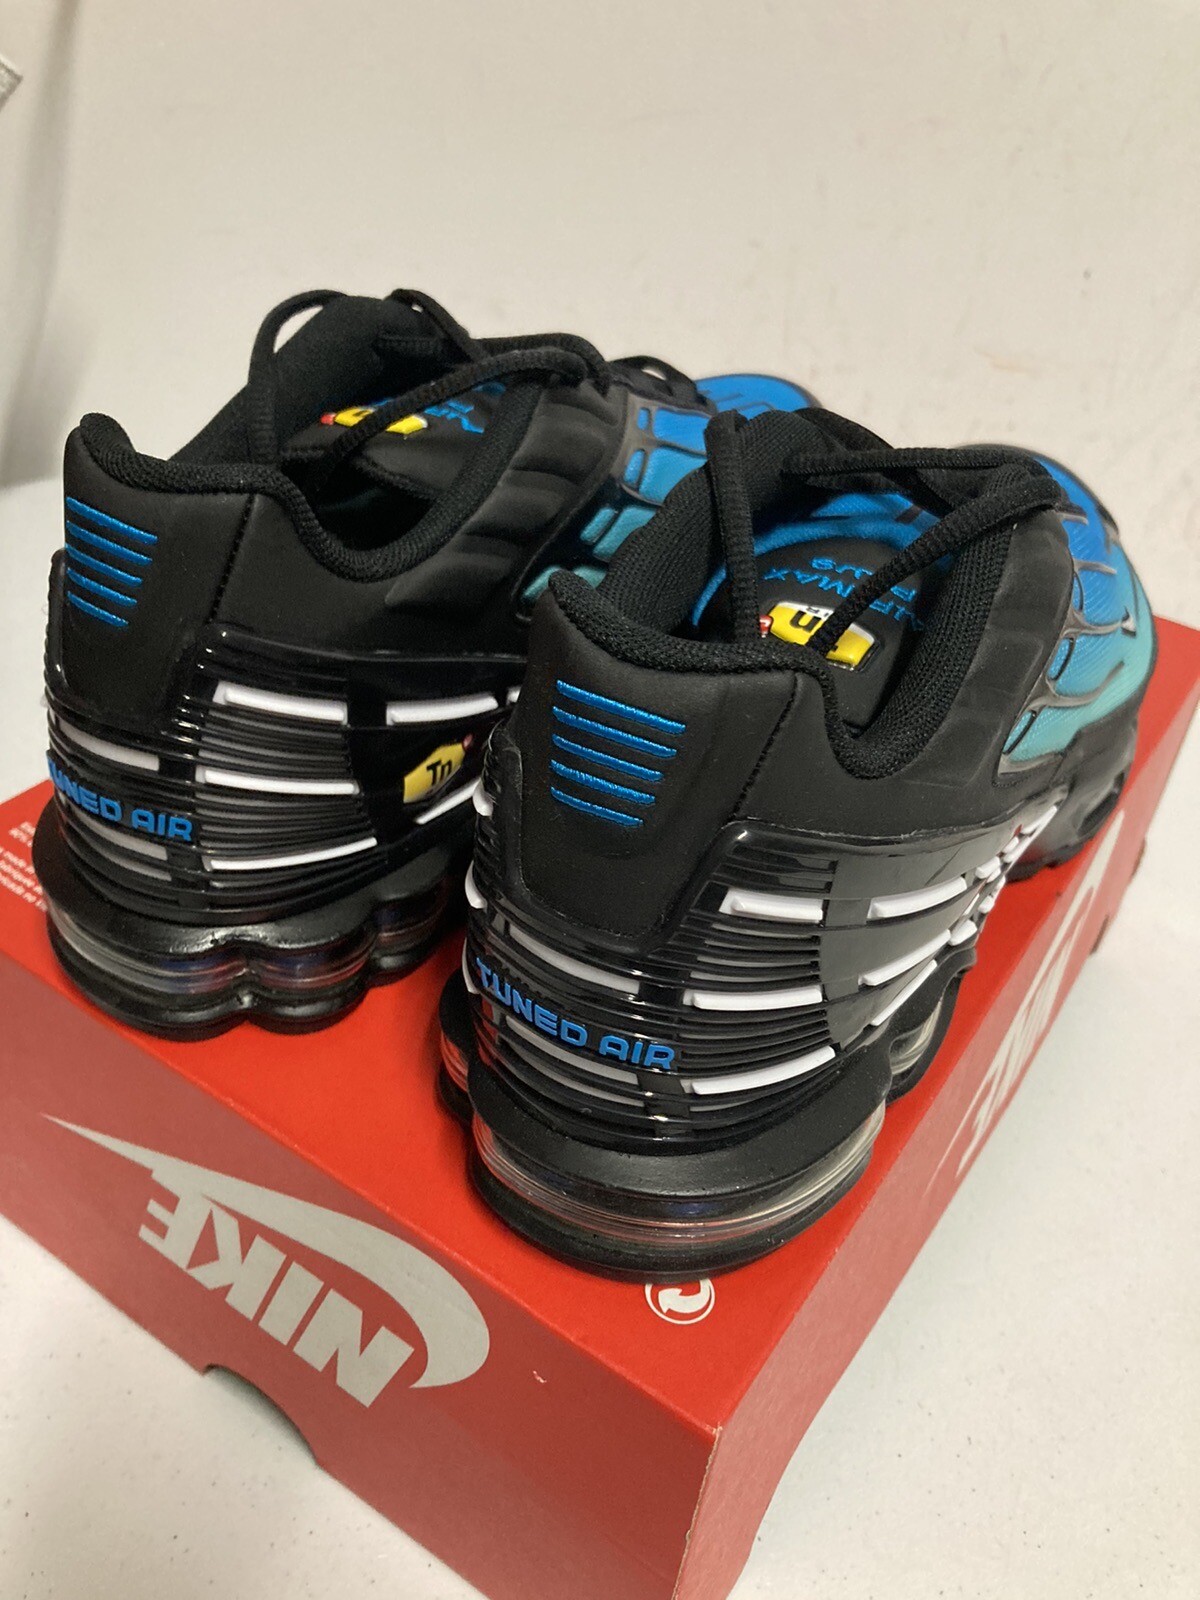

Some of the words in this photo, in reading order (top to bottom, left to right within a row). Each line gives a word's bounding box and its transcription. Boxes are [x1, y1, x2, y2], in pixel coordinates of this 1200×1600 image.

[764, 568, 855, 598] MAX
[426, 758, 453, 787] Tn
[131, 808, 194, 842] AIR
[476, 957, 589, 1047] TUNED
[598, 1035, 676, 1070] AIR
[138, 1168, 415, 1408] NIKE
